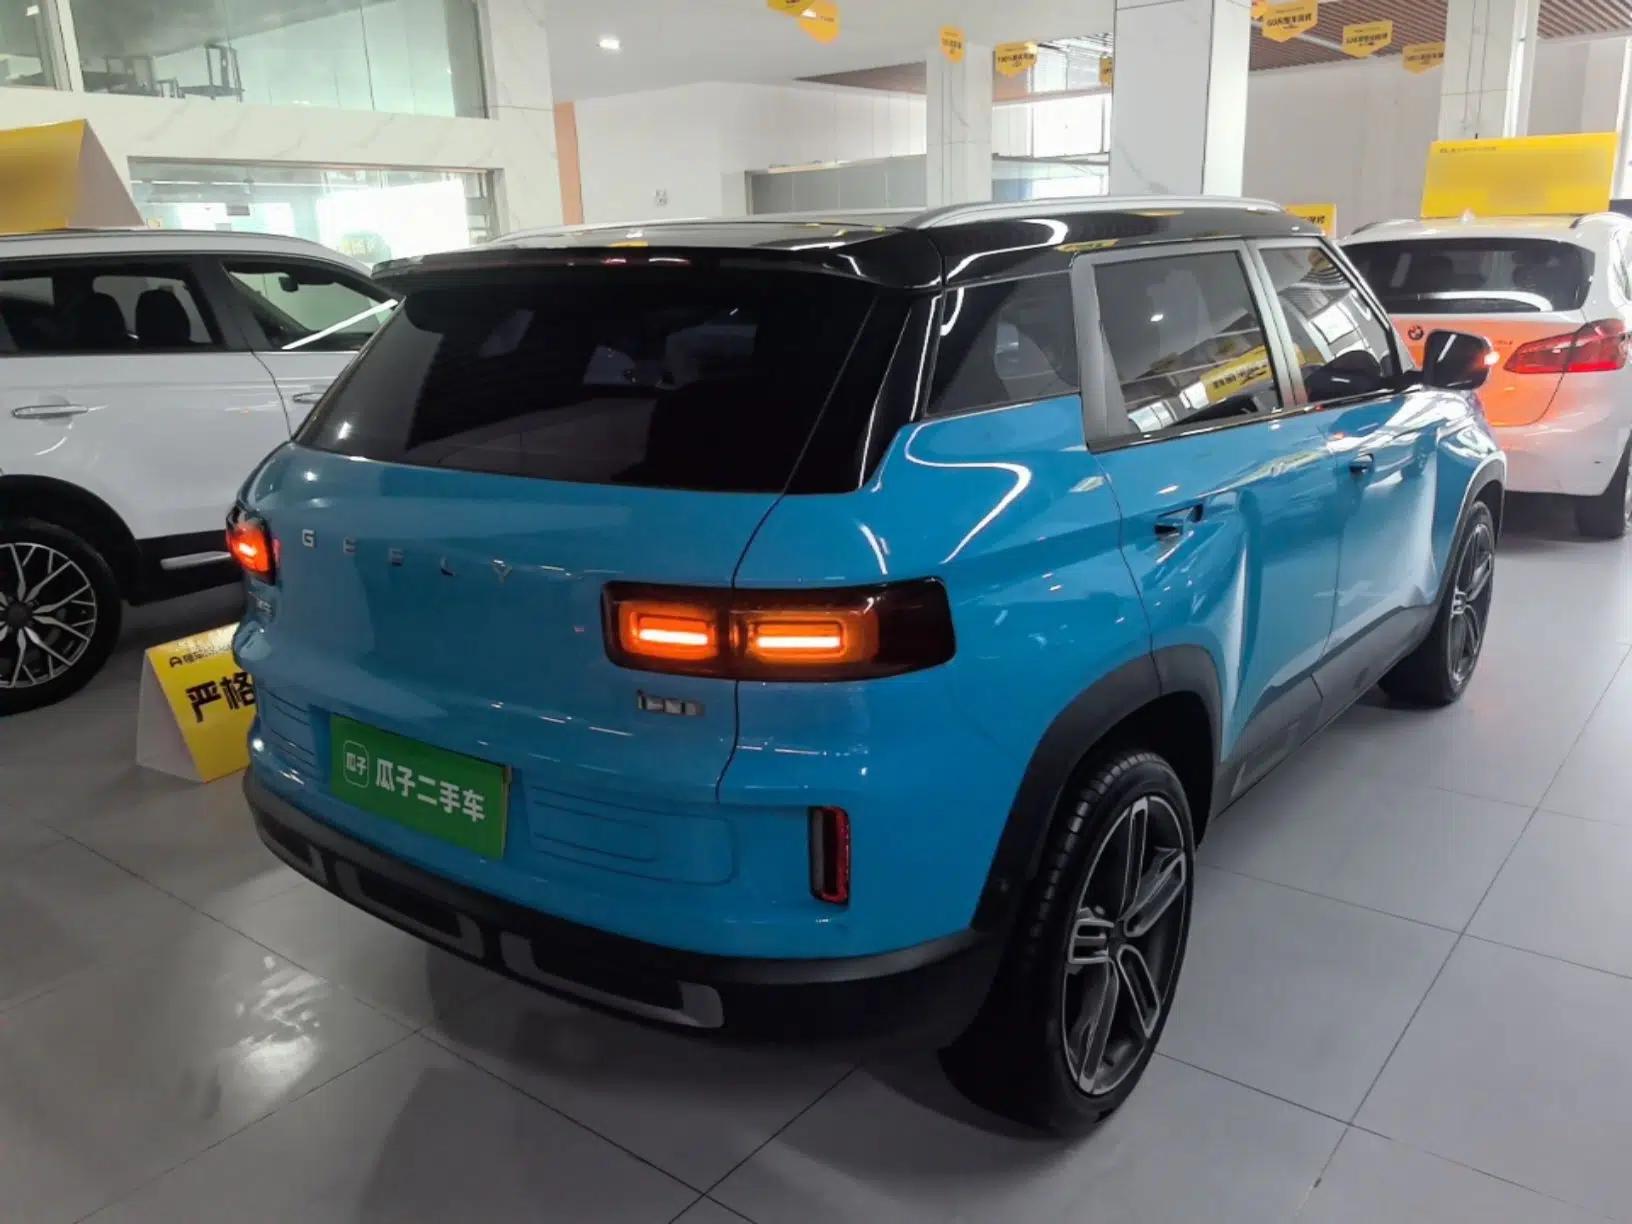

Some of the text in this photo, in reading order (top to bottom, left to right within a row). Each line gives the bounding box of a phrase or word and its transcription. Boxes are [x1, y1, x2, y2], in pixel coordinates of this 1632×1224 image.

[301, 528, 513, 582] GEELY
[186, 671, 256, 723] 严格
[346, 751, 367, 776] 瓜子
[376, 757, 485, 822] 瓜子二手车
